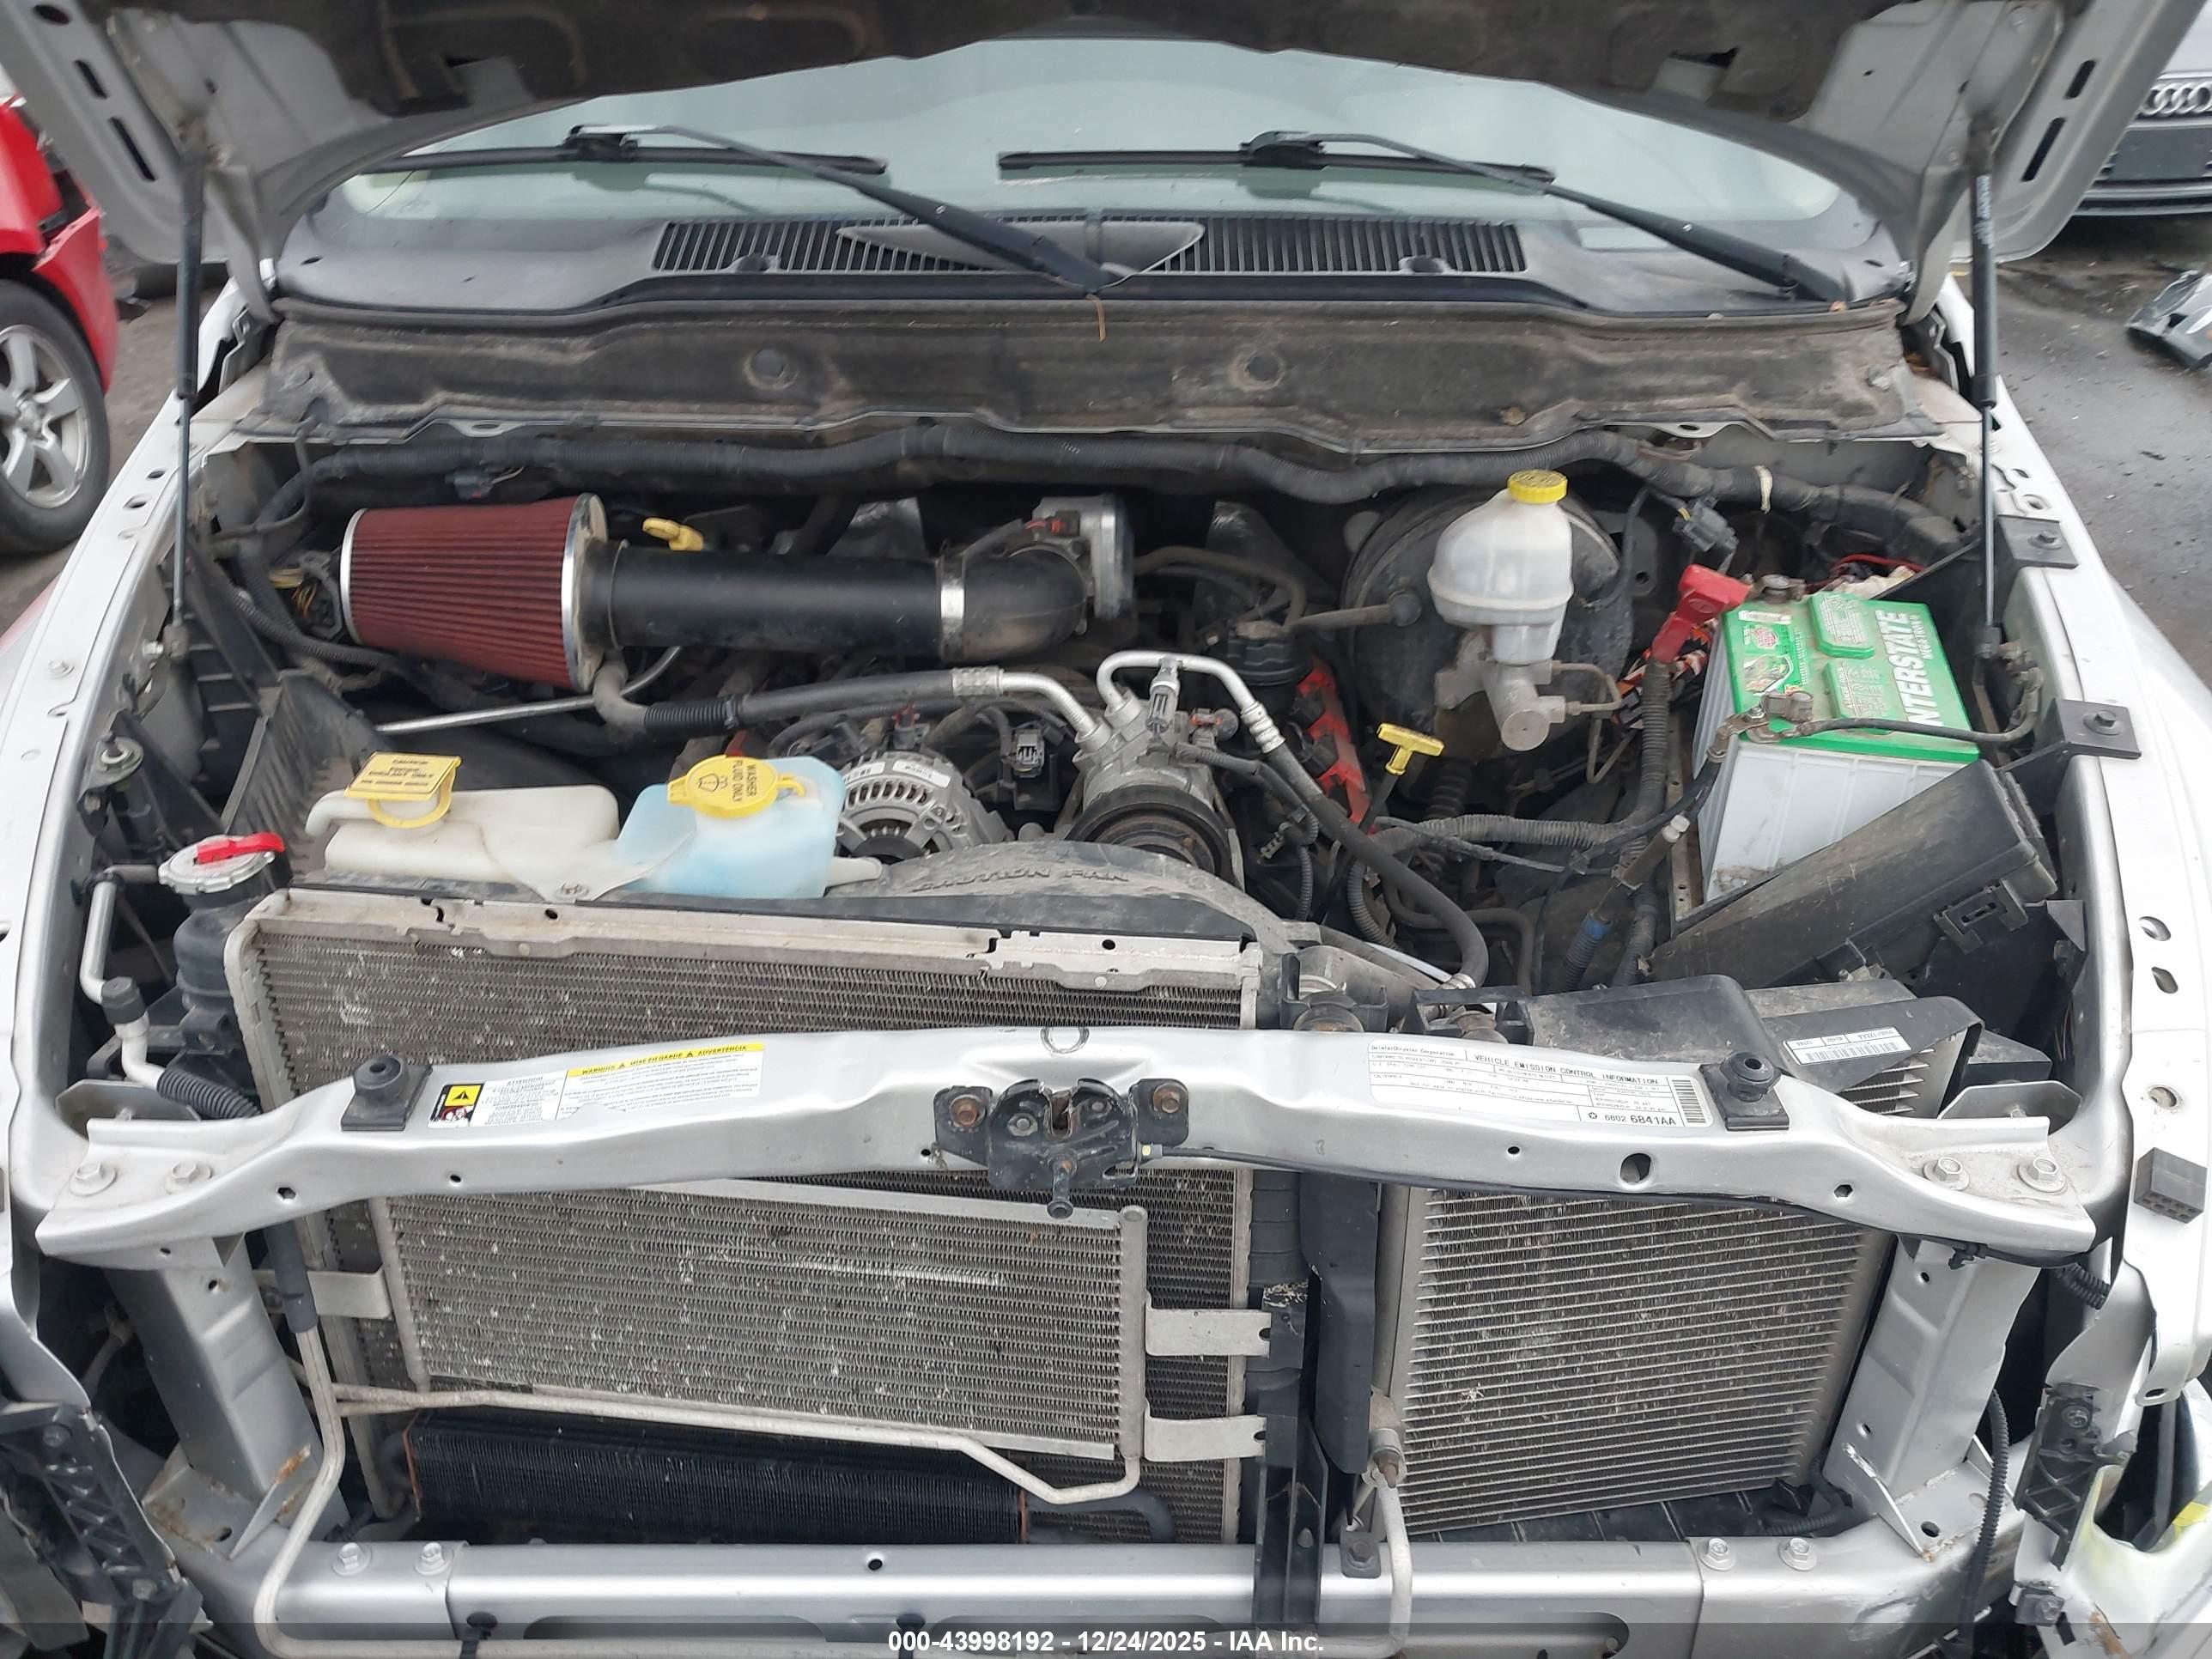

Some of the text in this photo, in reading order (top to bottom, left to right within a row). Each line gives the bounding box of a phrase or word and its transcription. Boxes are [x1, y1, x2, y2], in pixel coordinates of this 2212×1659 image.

[1875, 610, 1945, 726] NTERSTATE
[732, 760, 744, 802] FLUID ONLY
[745, 763, 757, 797] WASHER
[911, 866, 1129, 893] CAUTION FAN
[1474, 1054, 1510, 1066] VEHICLE
[1514, 1061, 1556, 1073] EMISSION
[1560, 1067, 1595, 1079] CONTROL
[1602, 1073, 1659, 1085] INFORMATION
[1630, 1115, 1677, 1127] 6841AA
